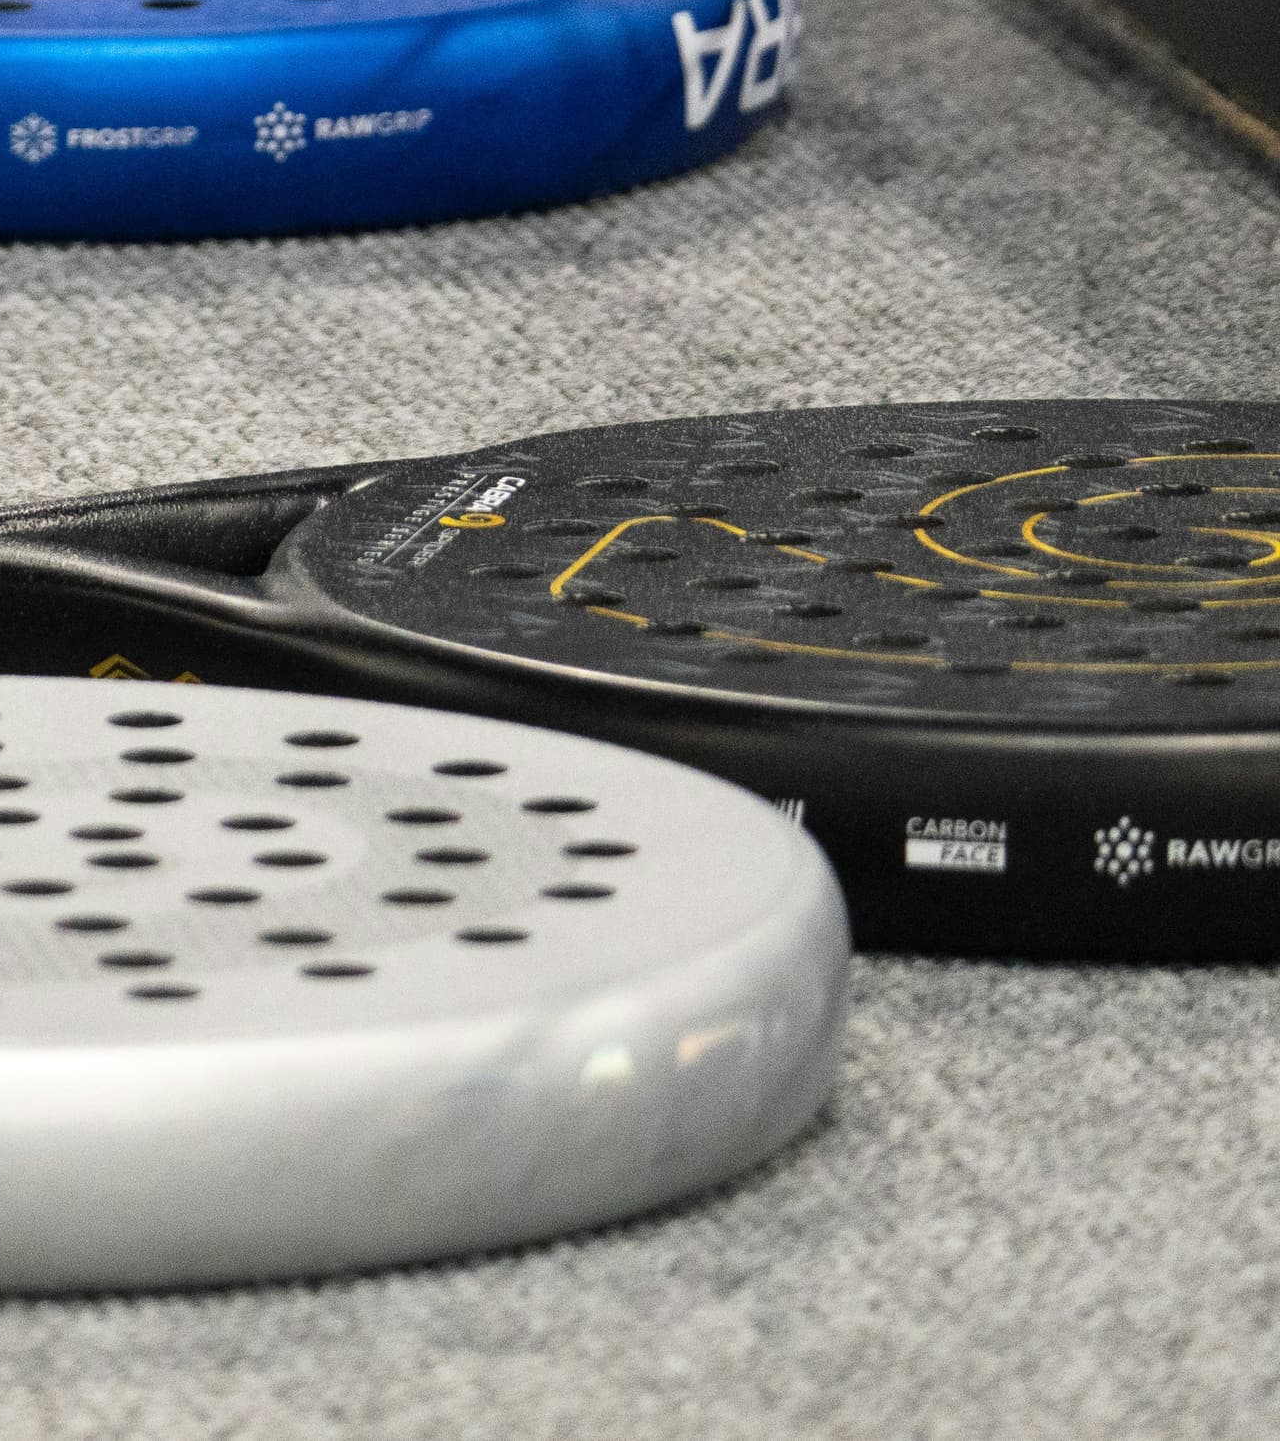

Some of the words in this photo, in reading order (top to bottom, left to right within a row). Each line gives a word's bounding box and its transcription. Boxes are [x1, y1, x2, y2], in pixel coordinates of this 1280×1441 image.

[313, 108, 434, 140] RAWGRIP
[464, 476, 526, 512] CABRA
[905, 816, 1007, 842] CARBON
[940, 842, 1001, 864] FACE
